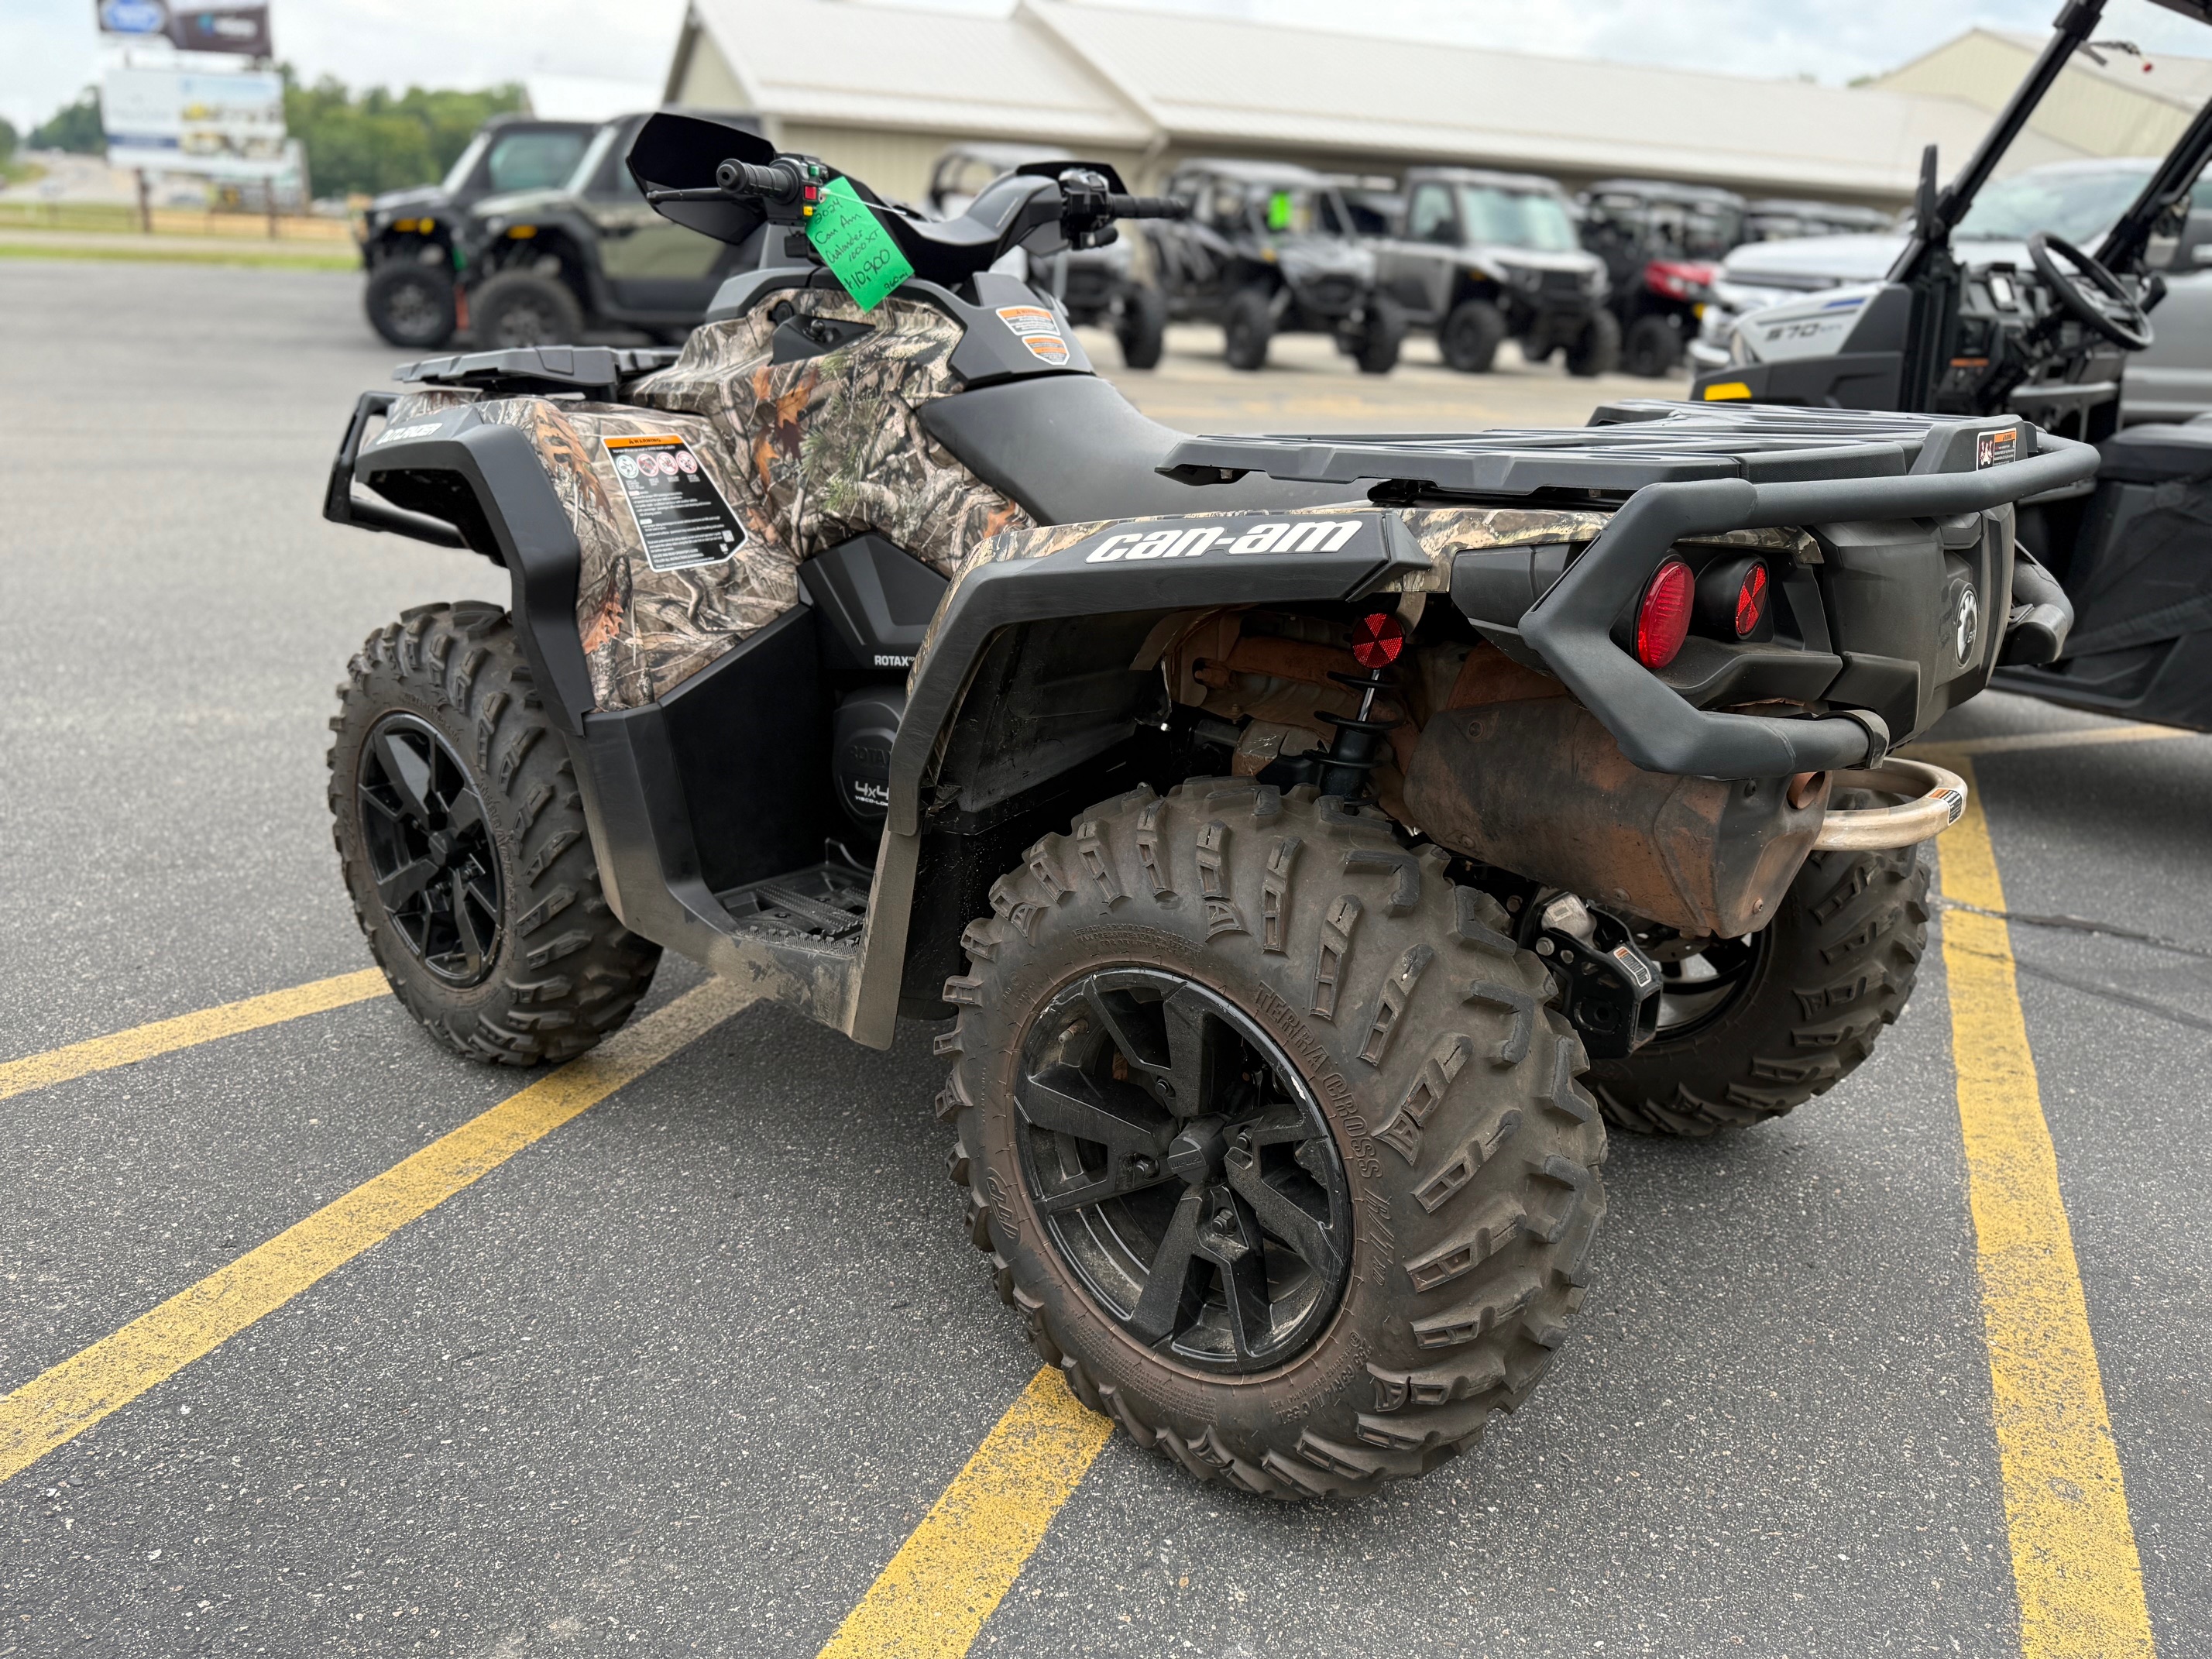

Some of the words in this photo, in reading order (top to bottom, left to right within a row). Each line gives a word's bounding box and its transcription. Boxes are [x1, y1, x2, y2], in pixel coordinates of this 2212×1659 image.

[815, 199, 843, 224] 2024
[849, 242, 867, 263] 1000
[865, 228, 878, 243] XT
[1086, 520, 1362, 563] can-am
[874, 655, 908, 667] ROTAX
[855, 781, 889, 801] 4x4
